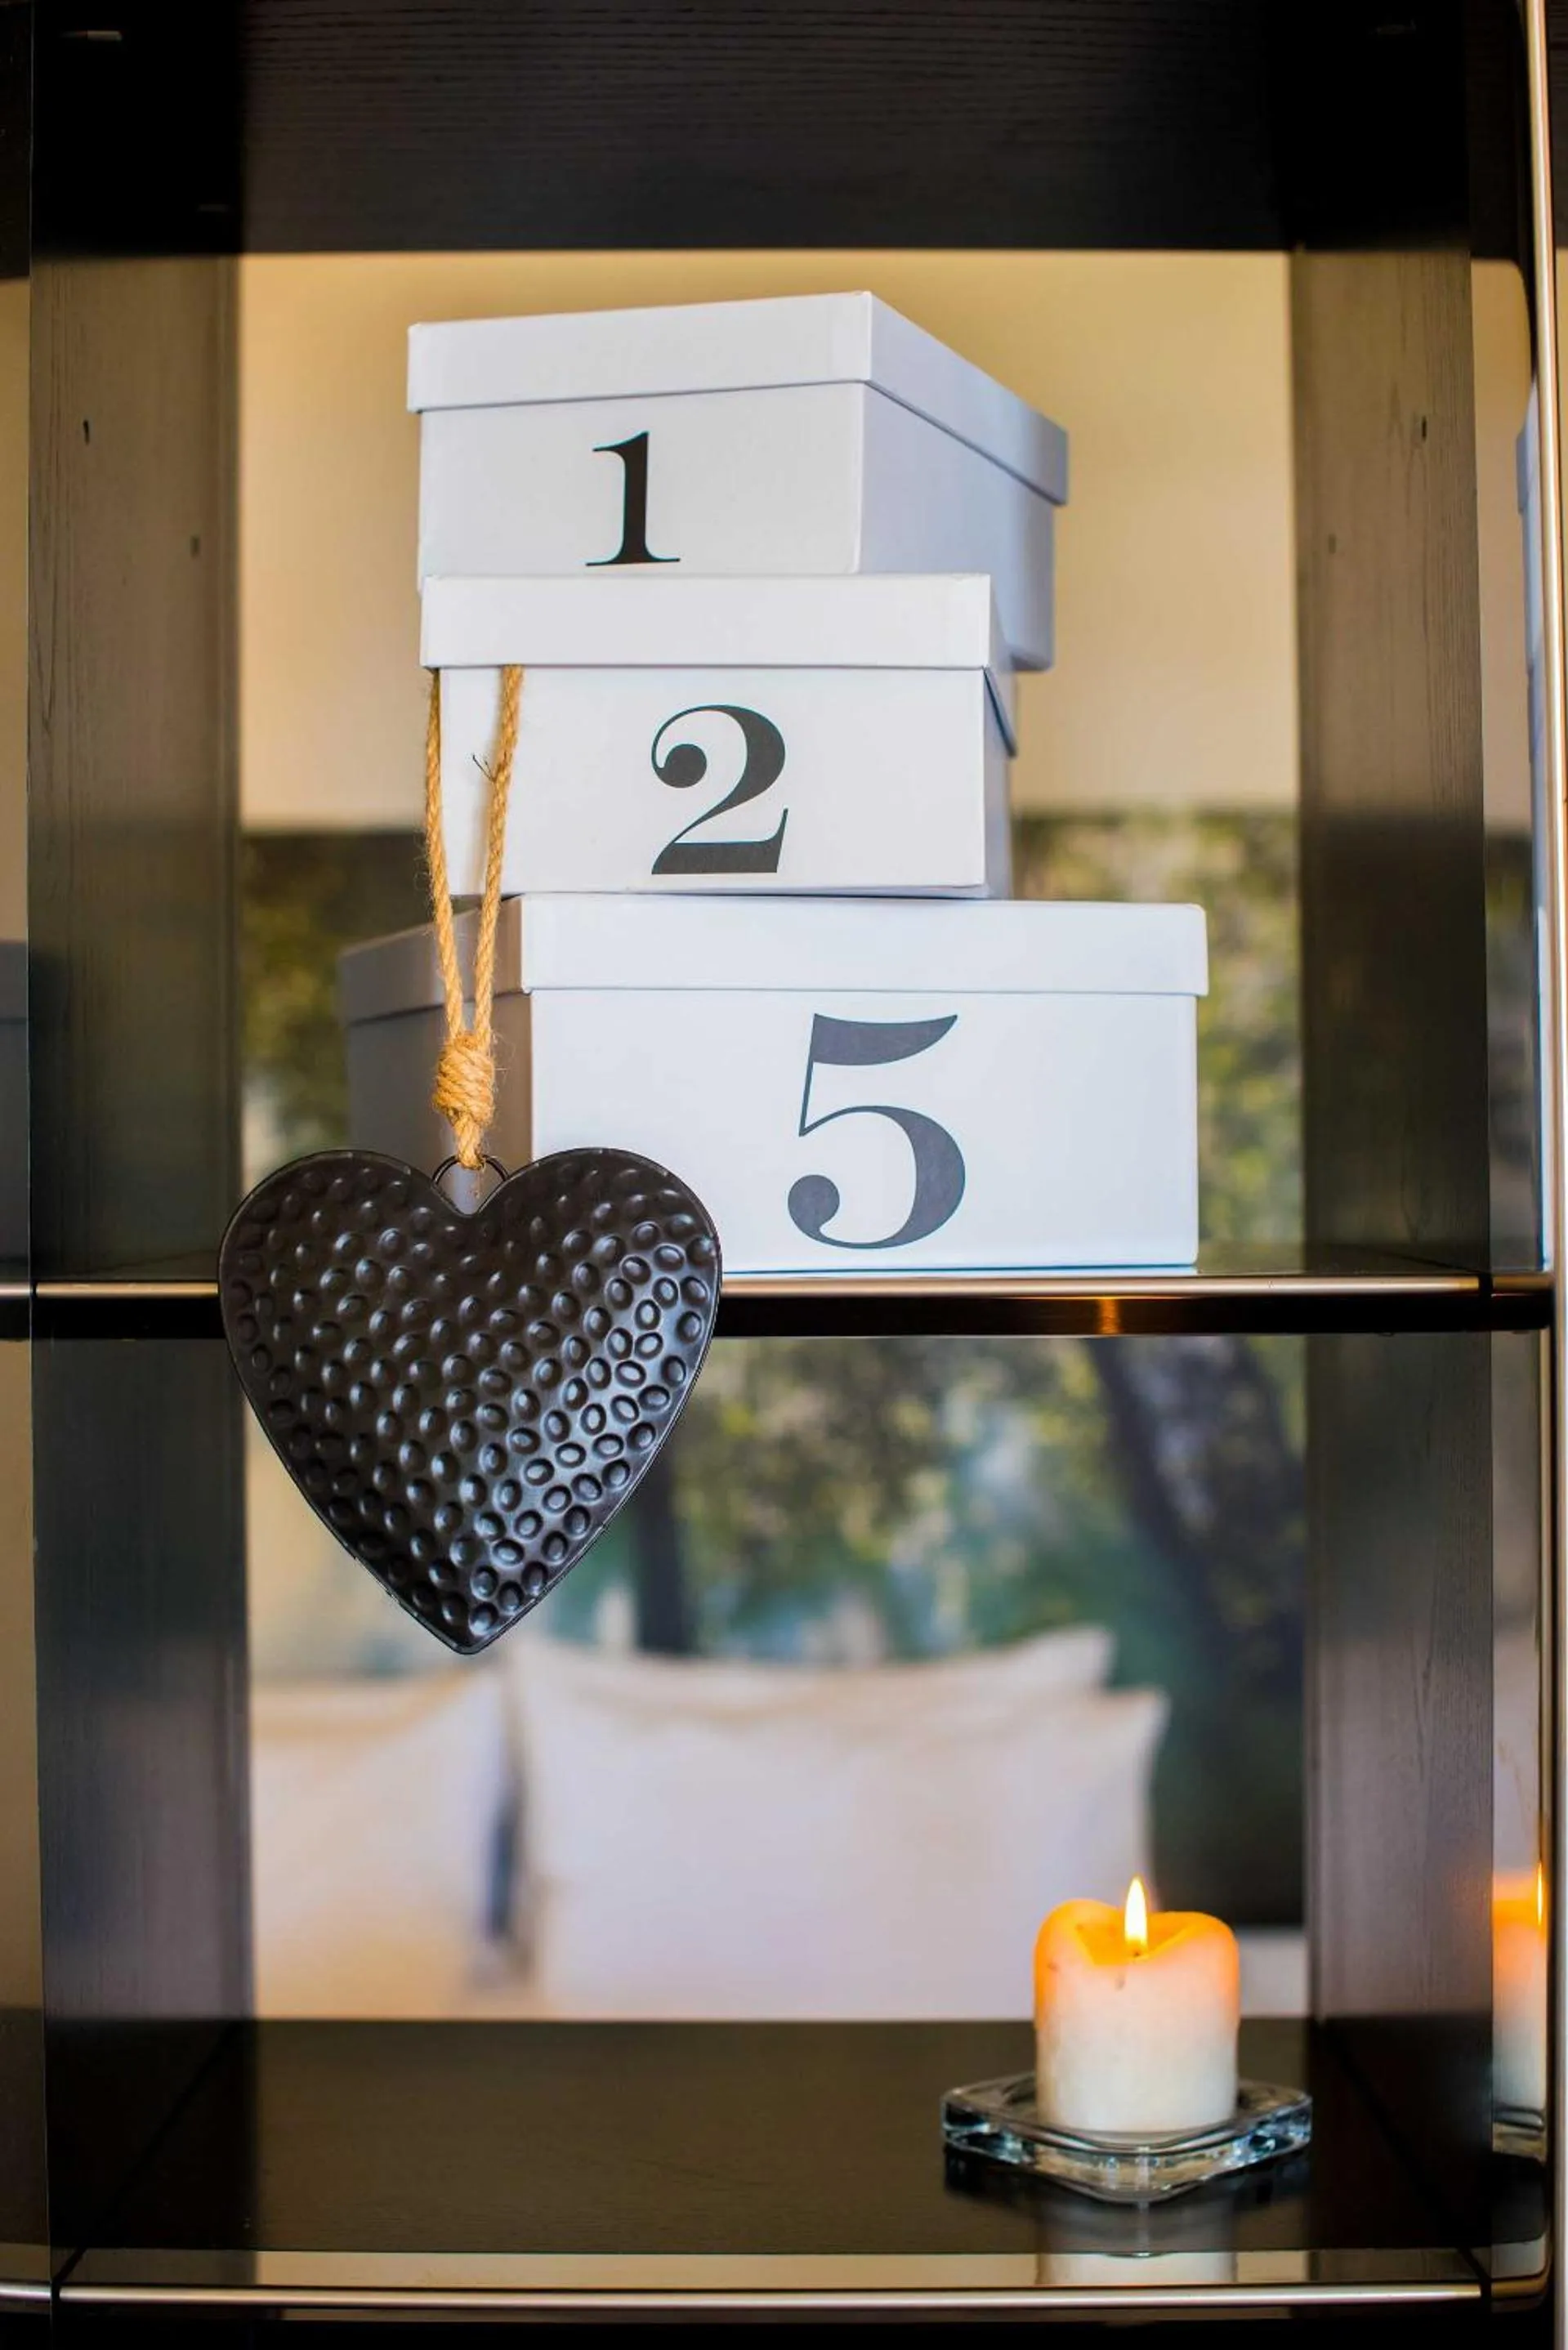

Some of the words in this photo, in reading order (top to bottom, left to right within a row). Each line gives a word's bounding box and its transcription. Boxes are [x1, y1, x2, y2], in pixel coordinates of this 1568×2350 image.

[585, 431, 681, 567] 1
[650, 704, 788, 875] 2
[787, 1012, 966, 1249] 5
